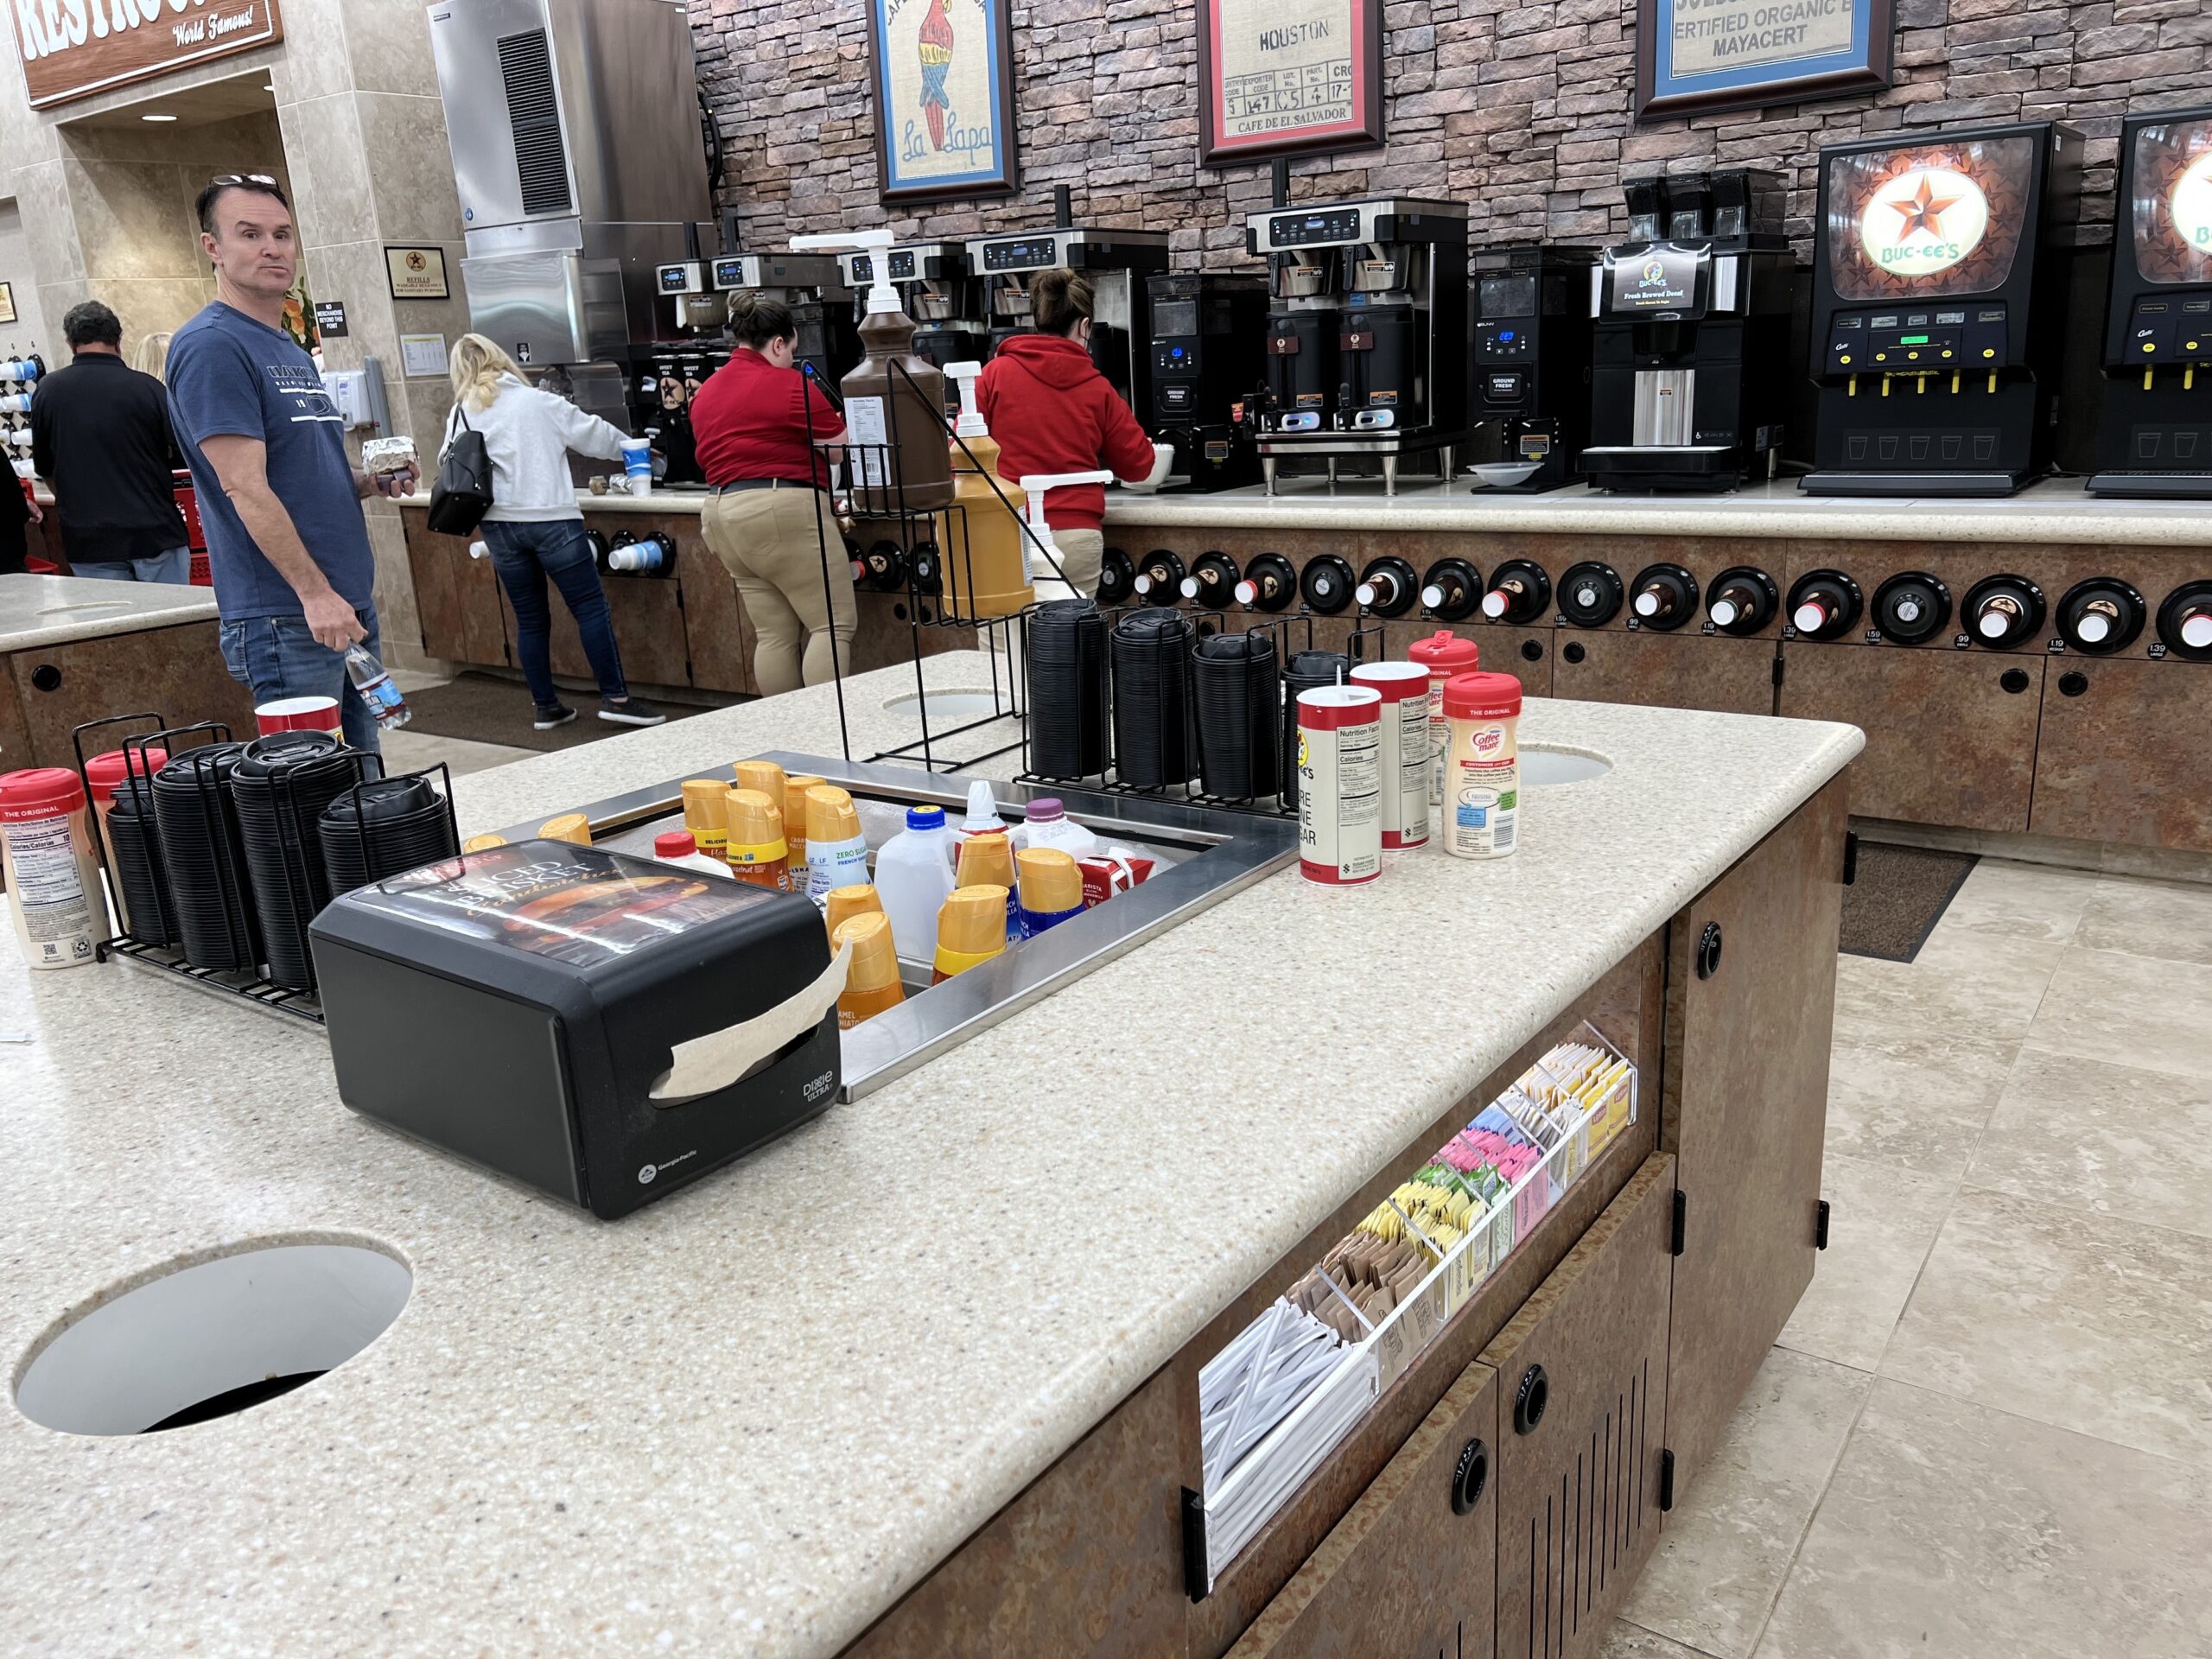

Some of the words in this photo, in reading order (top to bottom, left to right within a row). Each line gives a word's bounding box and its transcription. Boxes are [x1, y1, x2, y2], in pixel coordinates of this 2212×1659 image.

[1754, 0, 1835, 27] ORGANIC
[173, 24, 205, 47] World
[208, 5, 253, 41] Famous!
[1260, 19, 1329, 51] HOUSTON
[1713, 24, 1808, 56] MAYACERT
[1244, 74, 1273, 85] EXPORTER
[1238, 119, 1263, 132] CAFE
[1266, 118, 1278, 128] DE
[1281, 116, 1293, 127] EL
[1294, 108, 1346, 125] SALVADOR
[903, 119, 927, 162] La
[1402, 700, 1424, 709] Nutrition
[1472, 733, 1500, 746] Coffee
[1479, 742, 1499, 752] mate
[21, 805, 59, 817] ORIGINAL
[836, 850, 855, 860] ZERO
[454, 862, 594, 906] BRISKET
[807, 1085, 830, 1103] ULTRA
[658, 1149, 697, 1171] Georgia-Pacific
